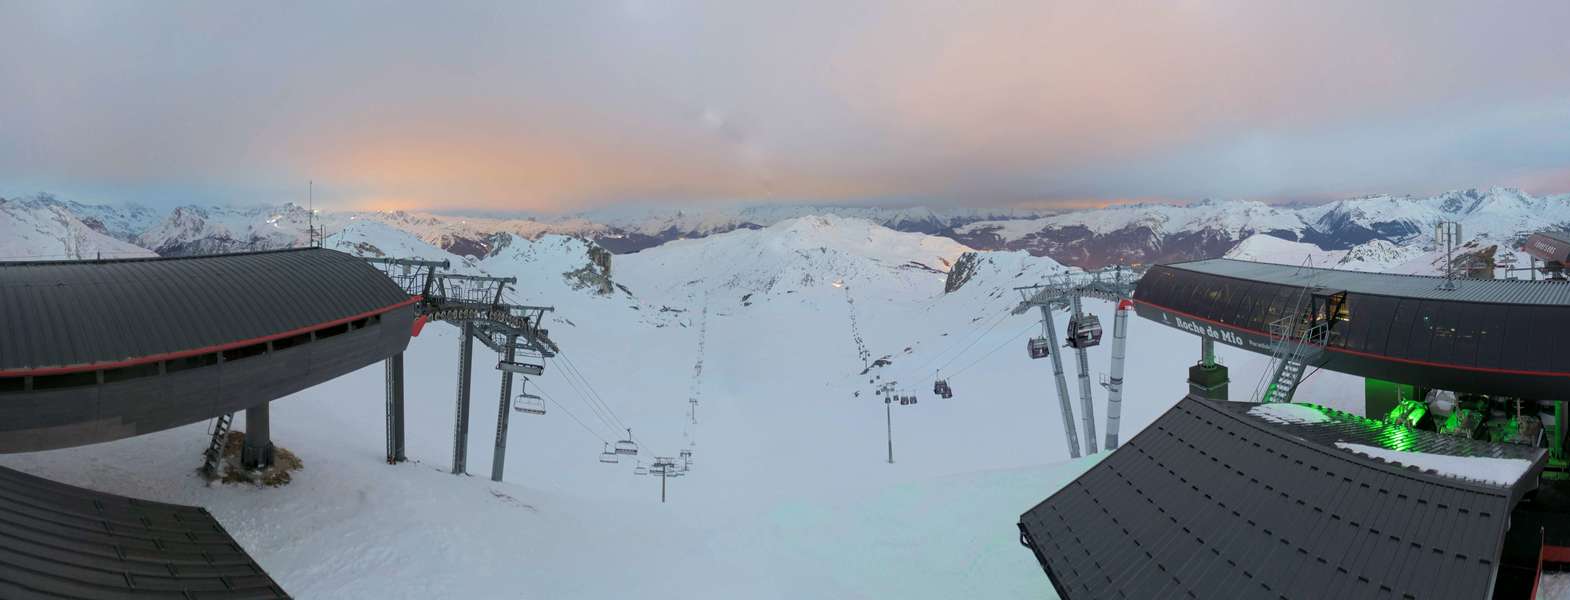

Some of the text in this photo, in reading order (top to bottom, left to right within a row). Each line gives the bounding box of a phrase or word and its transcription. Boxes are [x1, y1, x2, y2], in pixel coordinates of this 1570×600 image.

[1175, 317, 1206, 335] Roche
[1206, 325, 1220, 339] de
[1221, 329, 1244, 346] Mio
